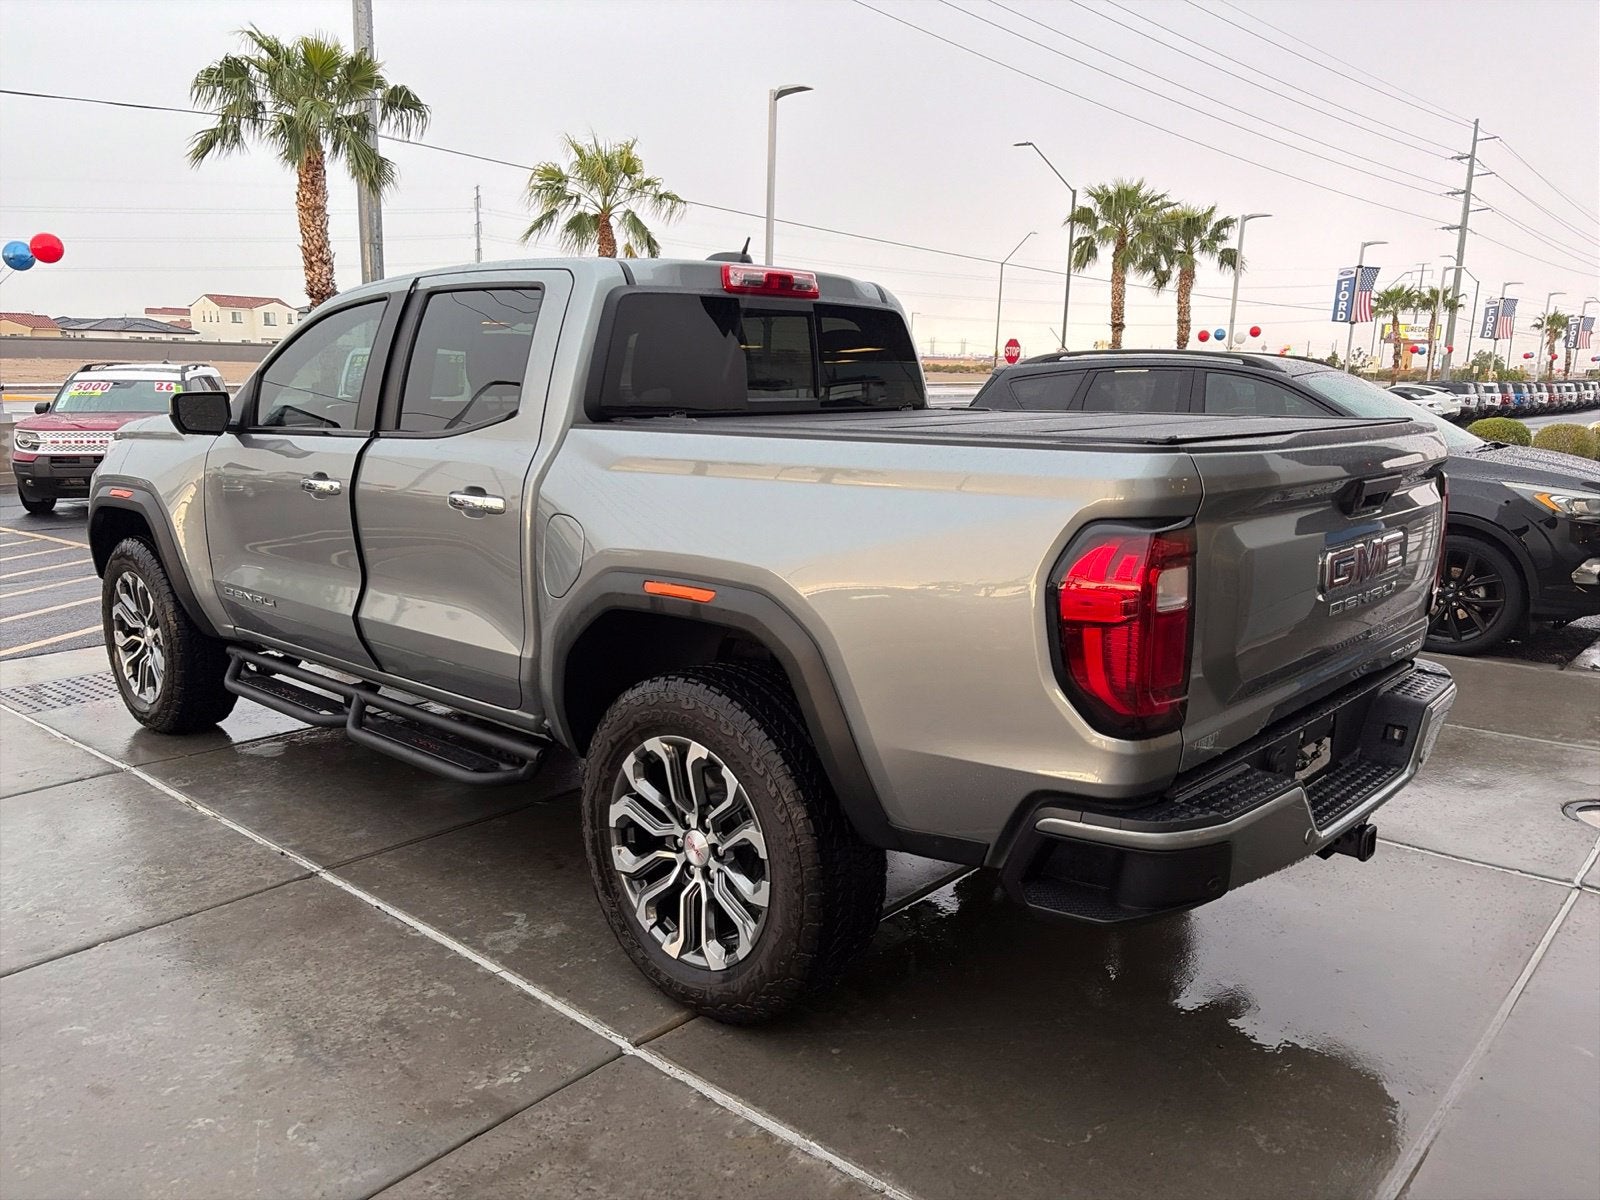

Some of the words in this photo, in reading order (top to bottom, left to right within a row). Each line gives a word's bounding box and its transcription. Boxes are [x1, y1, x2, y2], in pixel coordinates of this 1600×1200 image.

[1337, 280, 1350, 321] FORD
[1483, 308, 1495, 338] FORD
[1567, 324, 1577, 348] FORD
[1005, 346, 1020, 357] STOP
[156, 382, 174, 391] 26
[1326, 531, 1404, 591] GMC
[224, 586, 277, 608] DENALI
[1328, 580, 1397, 617] DENALI
